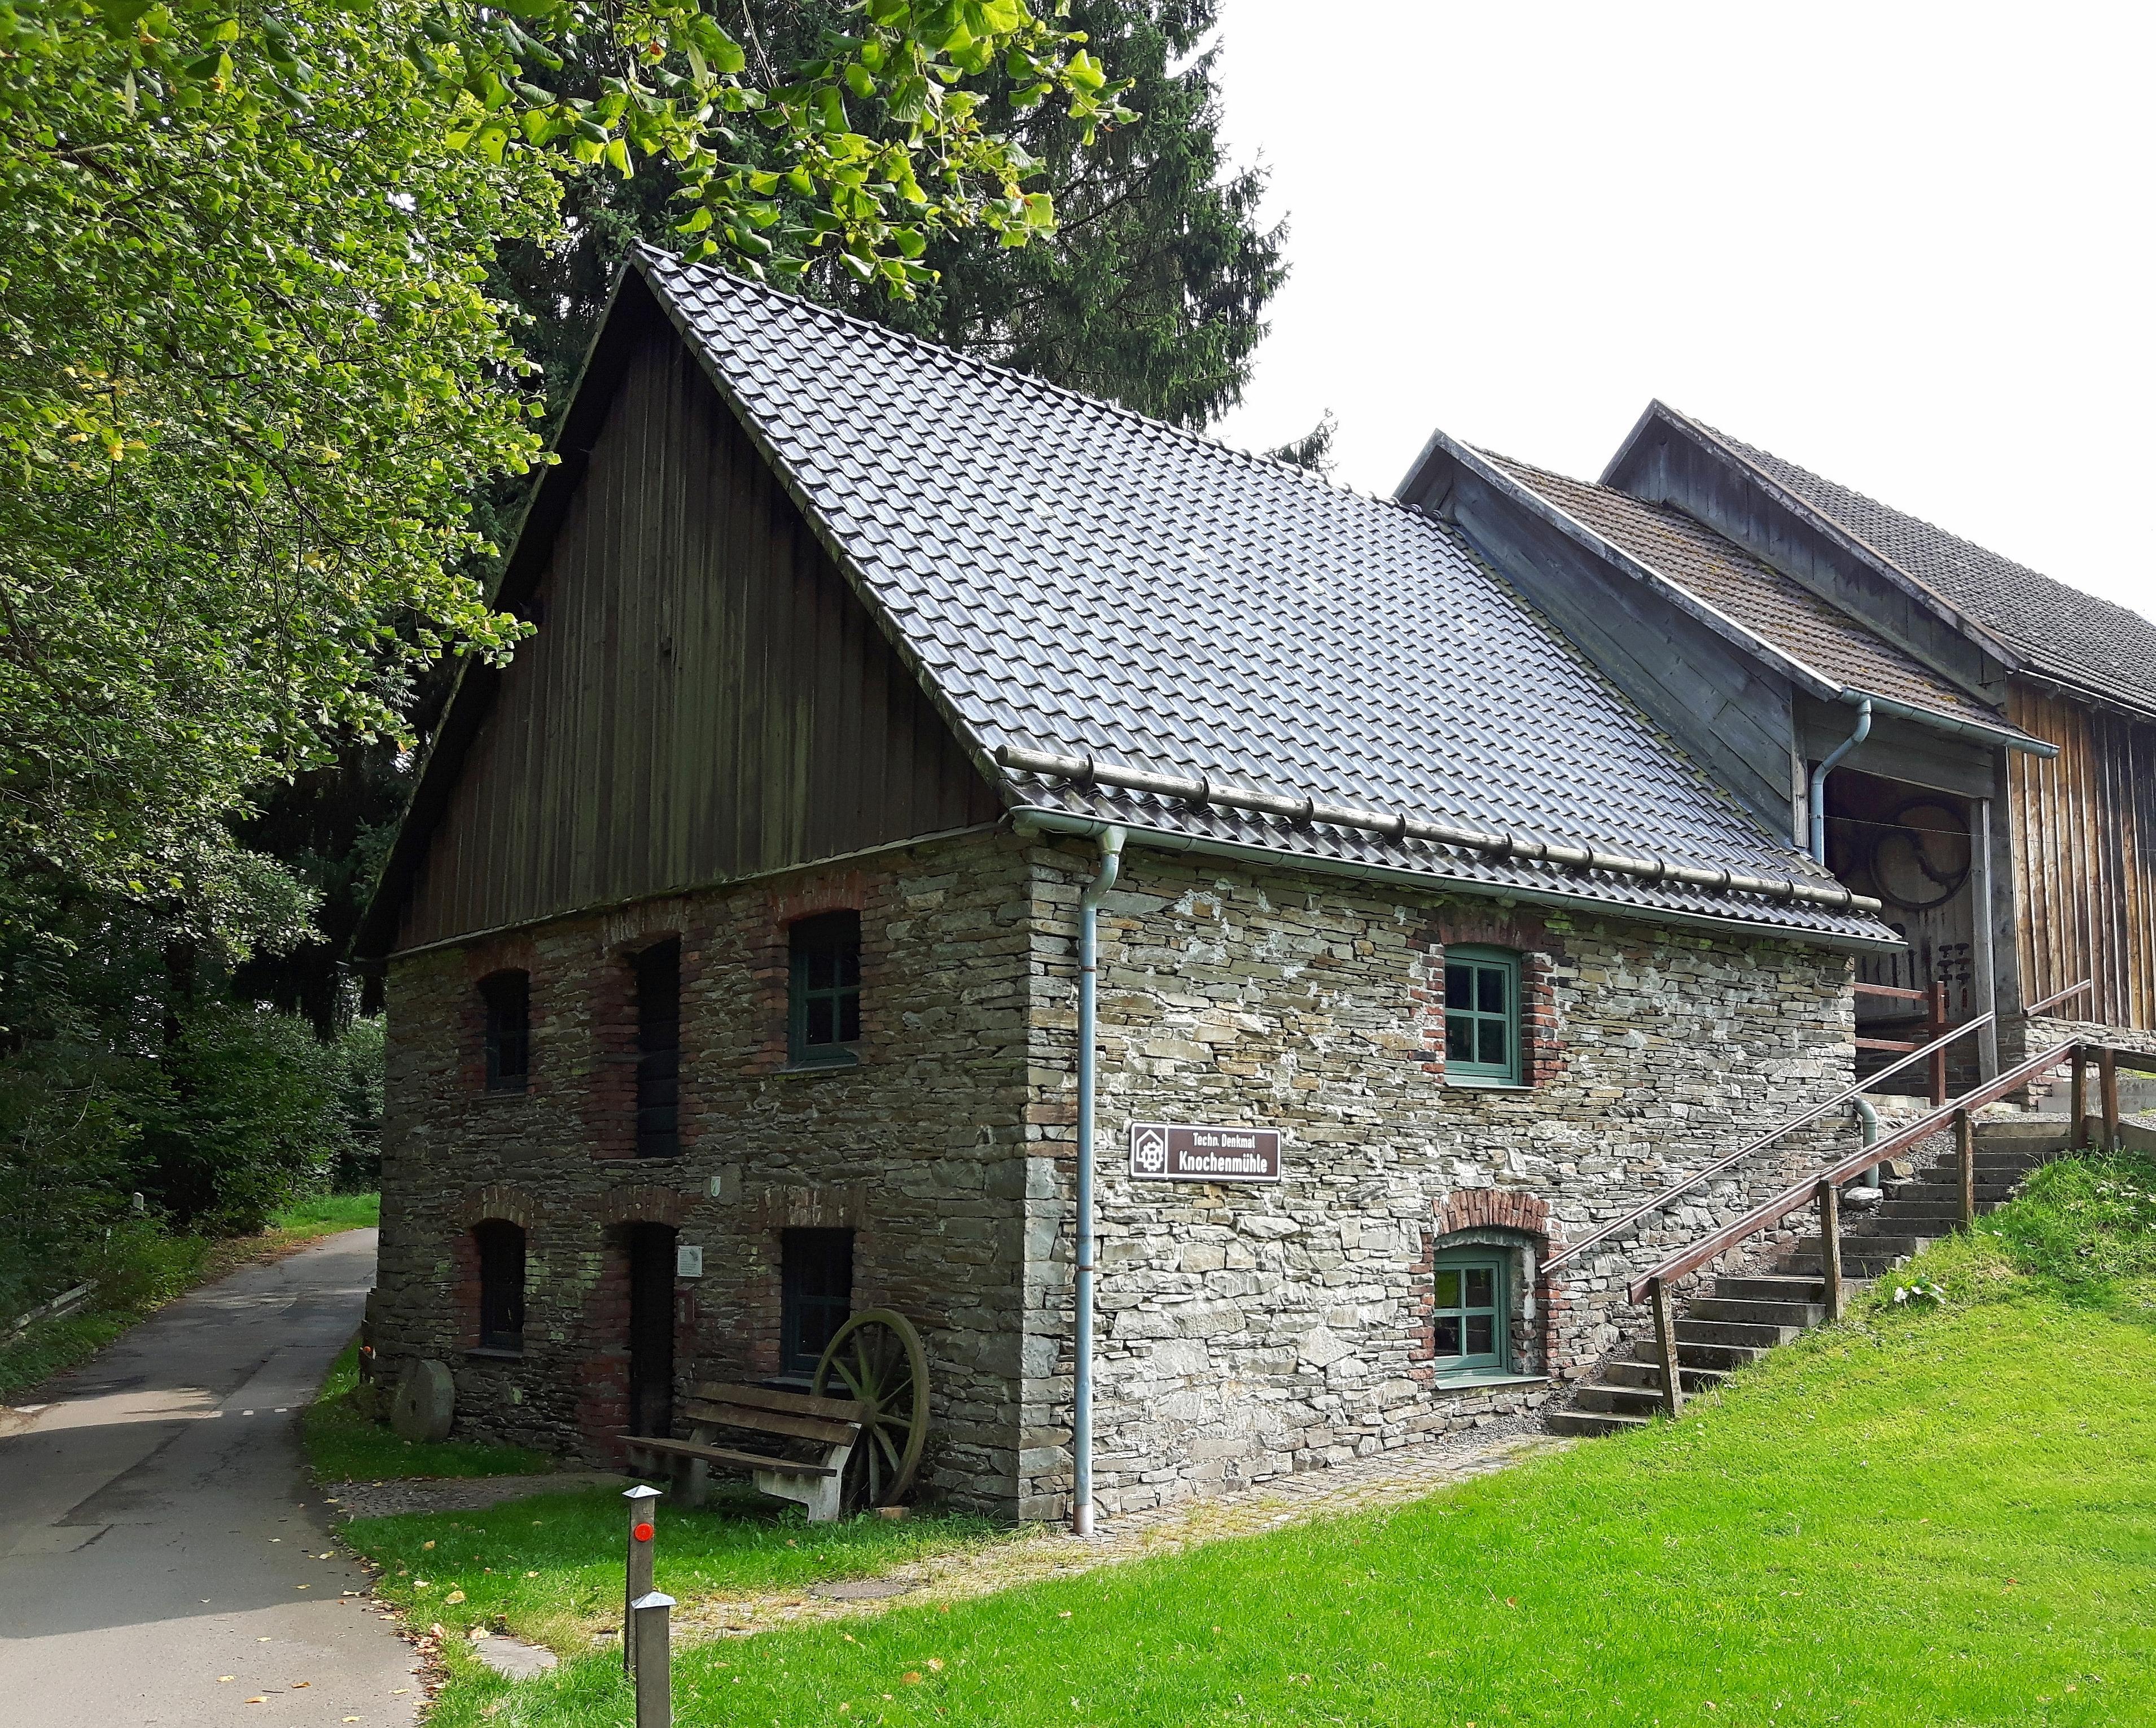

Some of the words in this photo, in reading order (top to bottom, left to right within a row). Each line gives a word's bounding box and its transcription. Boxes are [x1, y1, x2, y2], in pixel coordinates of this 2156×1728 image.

[1193, 1132, 1219, 1146] Techn.
[1221, 1133, 1256, 1148] Denkmal
[1179, 1150, 1268, 1173] Knochenmühle
